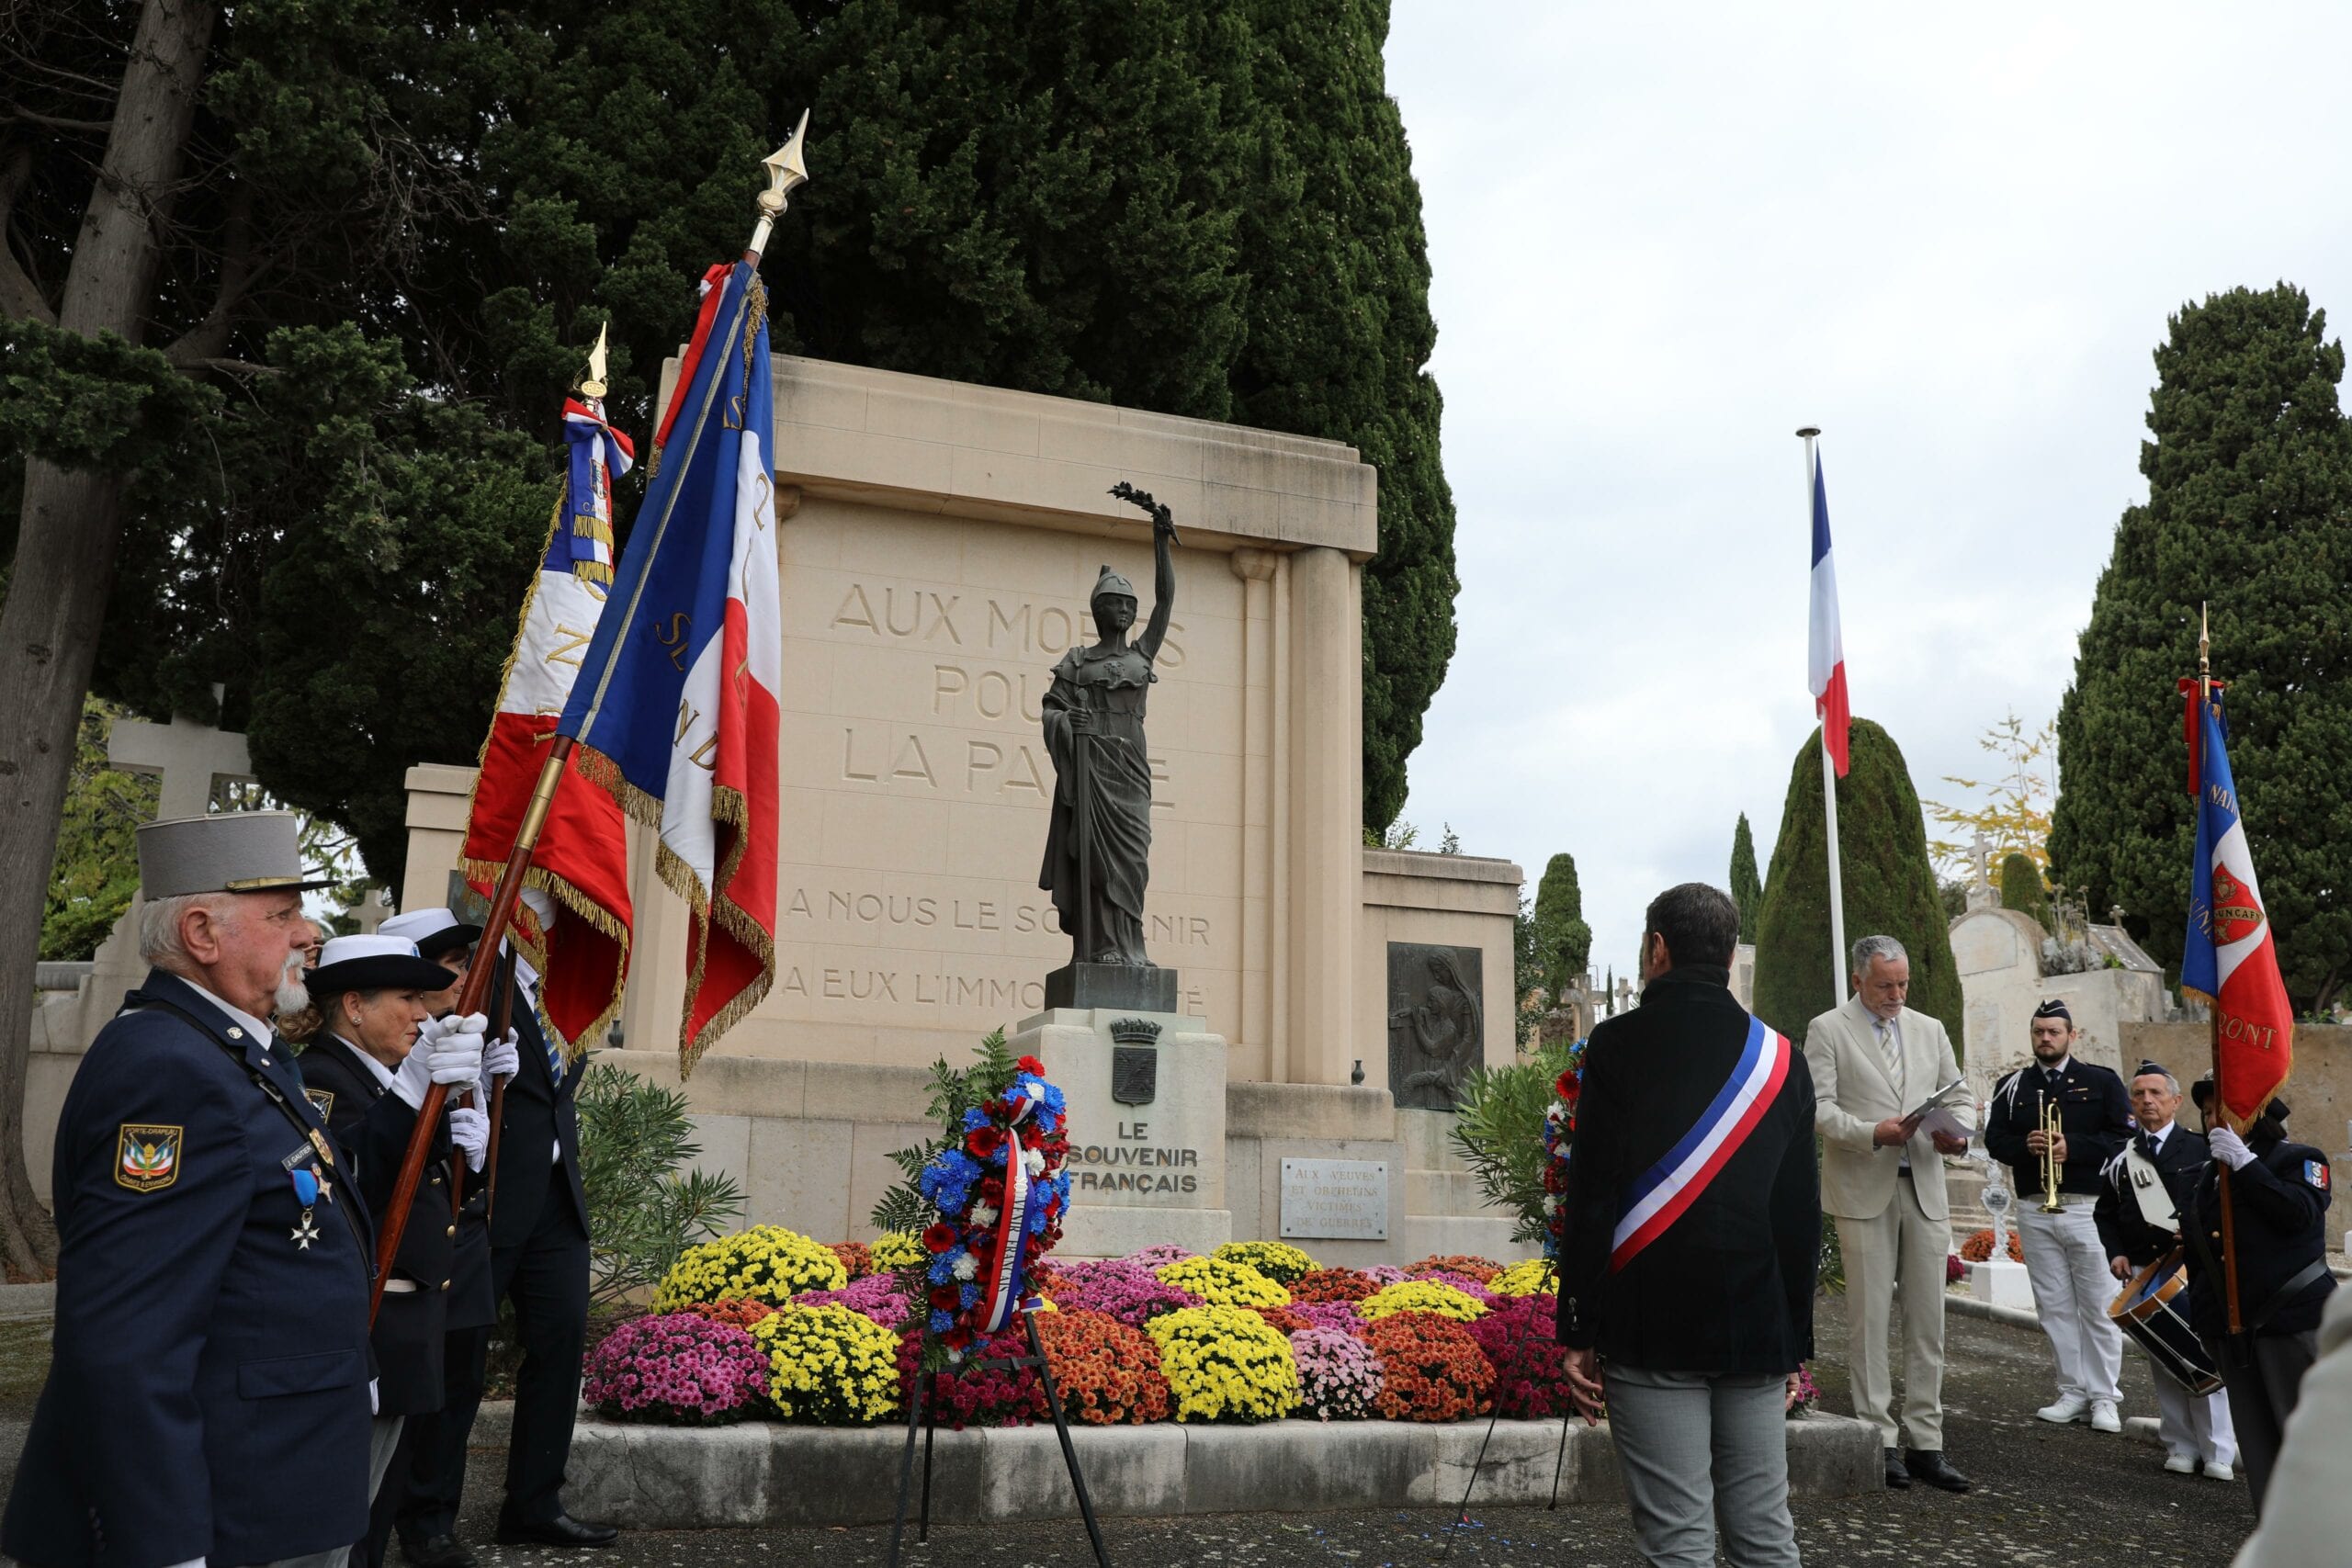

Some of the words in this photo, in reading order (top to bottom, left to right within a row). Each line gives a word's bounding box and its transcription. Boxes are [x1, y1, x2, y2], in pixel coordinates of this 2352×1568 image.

[831, 583, 962, 646] AUX
[933, 664, 1054, 725] POU
[842, 728, 938, 788] LA
[786, 888, 813, 919] A
[828, 890, 938, 927] NOUS
[954, 900, 1001, 931] LE
[1013, 906, 1211, 946] SONIR
[780, 966, 808, 998] A
[822, 968, 899, 1003] EUX
[2220, 1012, 2278, 1049] RONT
[1118, 1122, 1148, 1140] LE
[291, 1145, 312, 1163] GAUTIER
[1068, 1145, 1198, 1168] SOUVENIR
